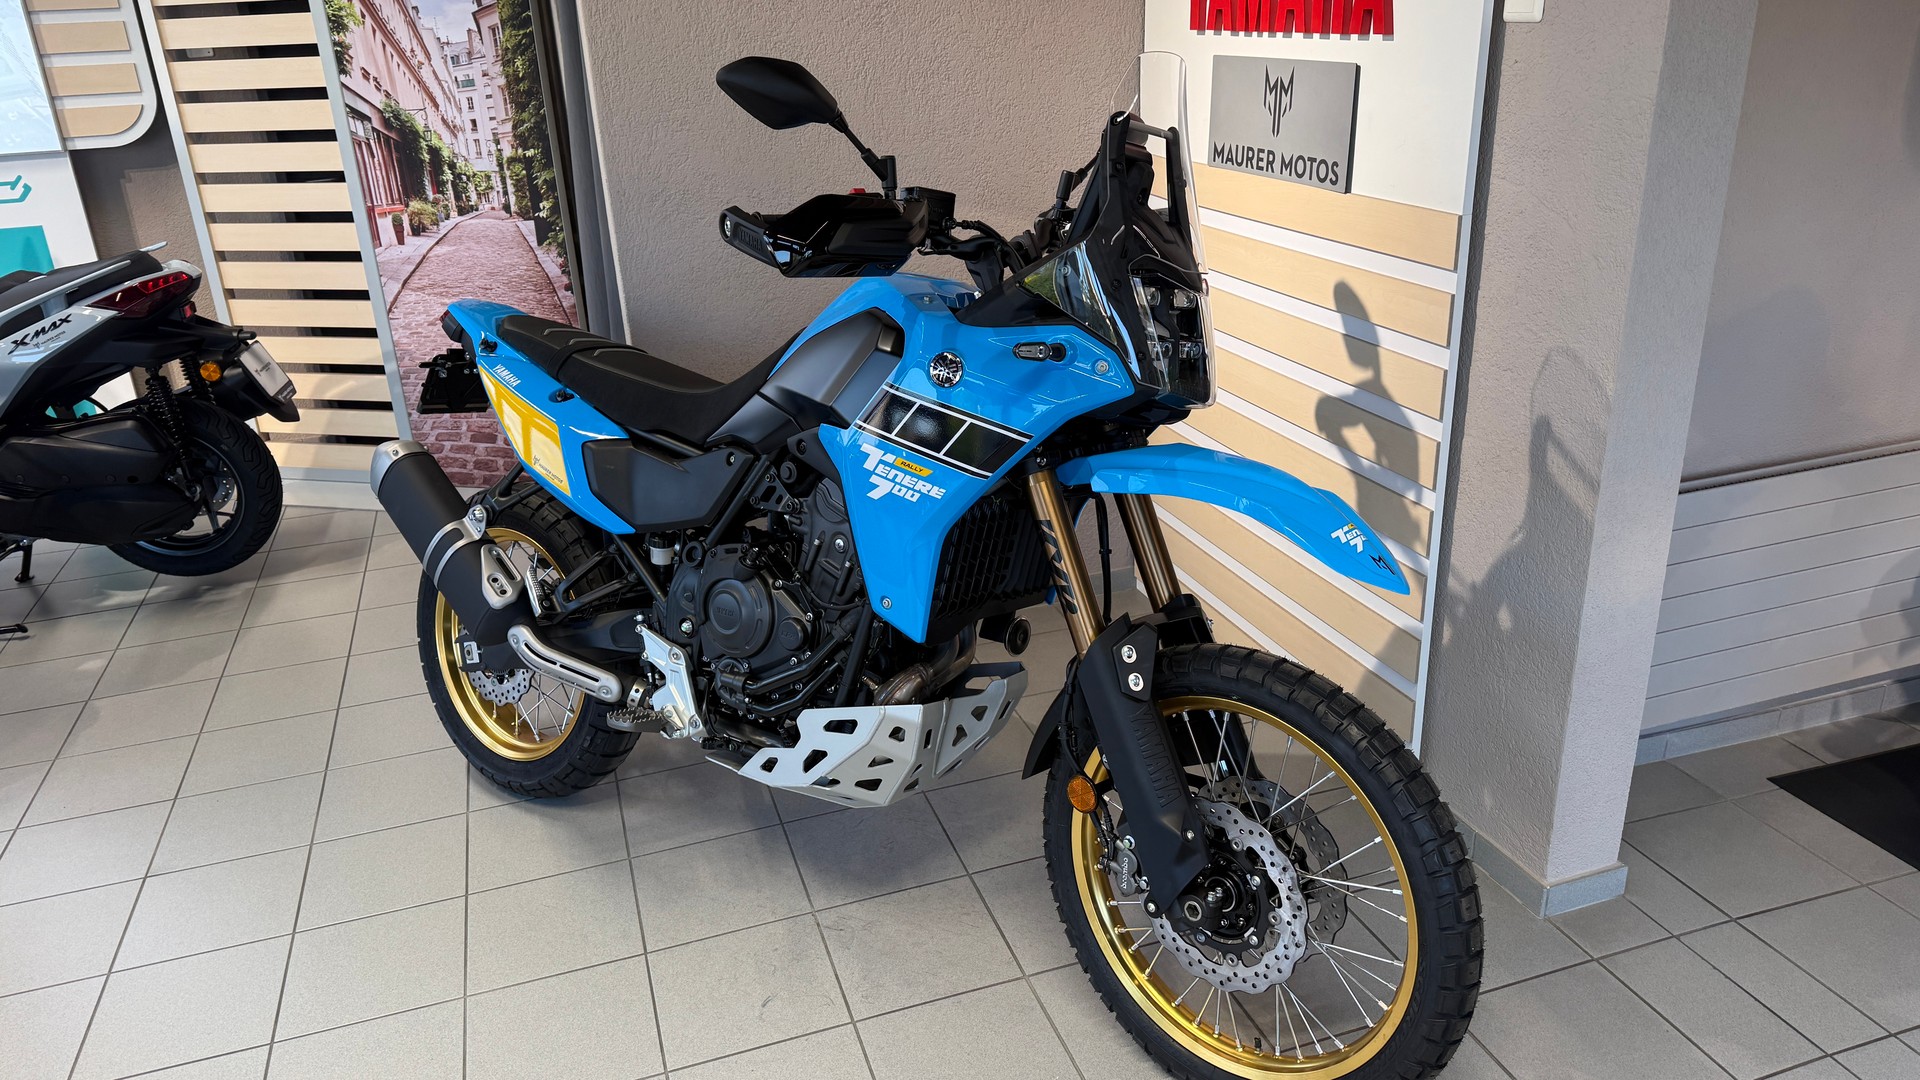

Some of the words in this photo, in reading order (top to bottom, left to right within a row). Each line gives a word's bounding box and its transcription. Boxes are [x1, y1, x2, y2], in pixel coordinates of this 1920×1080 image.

[1212, 141, 1276, 173] MAURER
[1280, 152, 1339, 186] MOTOS
[492, 363, 521, 387] YAMAHA
[900, 460, 924, 473] RALLY
[866, 474, 921, 502] 700
[1129, 703, 1182, 808] YAMAHA
[1120, 857, 1129, 889] brembo
